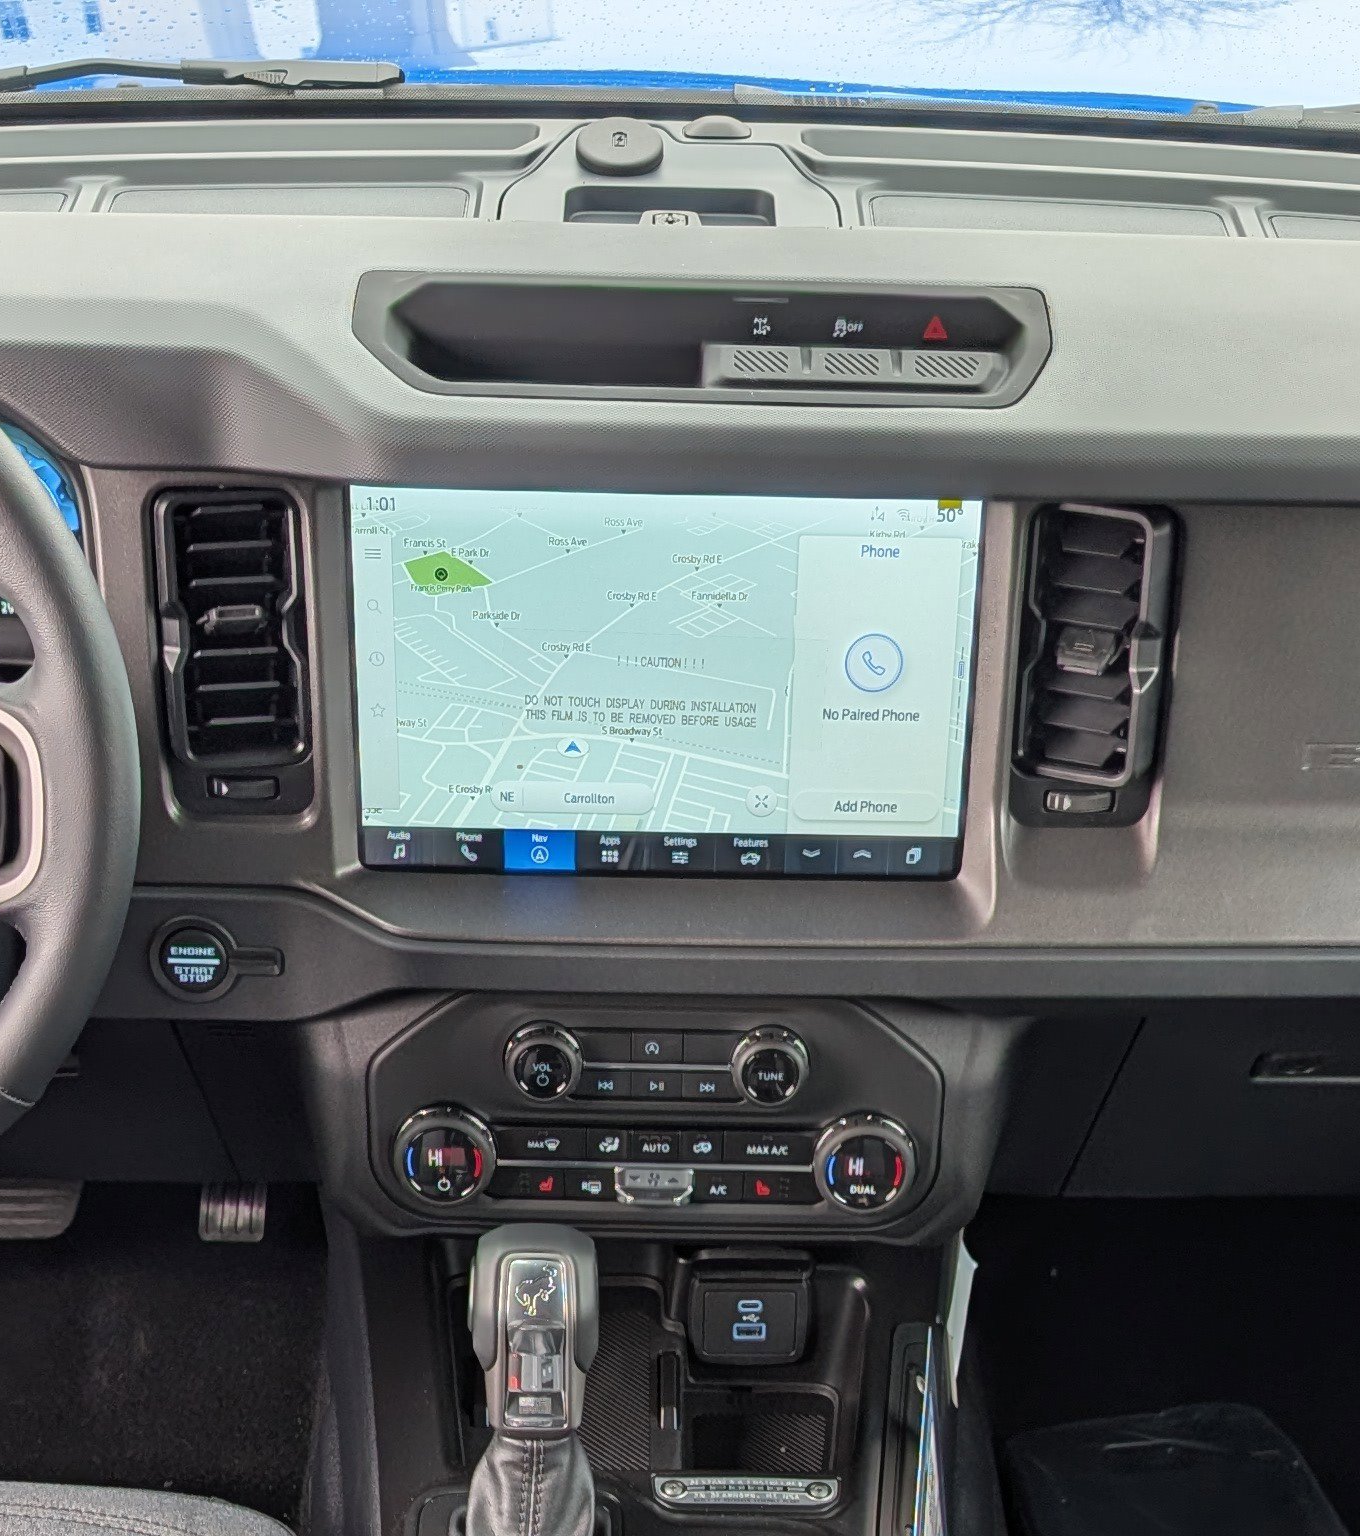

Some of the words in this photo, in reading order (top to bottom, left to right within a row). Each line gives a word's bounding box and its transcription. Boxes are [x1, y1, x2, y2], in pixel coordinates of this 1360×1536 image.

[366, 497, 396, 511] 1:01
[604, 517, 624, 526] Ross
[626, 517, 643, 527] Ave
[403, 538, 435, 548] Francis
[436, 539, 446, 548] St
[548, 537, 569, 546] Ross
[571, 537, 588, 546] Ave
[458, 549, 478, 558] Park
[479, 549, 490, 558] Dr
[861, 544, 900, 559] Phone
[672, 553, 702, 564] Crosby
[704, 554, 715, 563] Rd
[607, 591, 636, 601] Crosby
[638, 591, 649, 601] Rd
[472, 611, 509, 620] Parkside
[510, 611, 520, 620] Dr
[541, 642, 569, 653] Crosby
[571, 643, 583, 652] Rd
[524, 695, 539, 706] DO
[543, 696, 564, 707] NOT
[568, 697, 601, 708] TOUCH
[605, 698, 645, 709] DISPLAY
[650, 699, 686, 711] DURING
[691, 700, 757, 714] INSTALLATION
[525, 709, 546, 720] THIS
[551, 710, 573, 721] FILM
[578, 711, 587, 722] IS
[593, 712, 606, 722] TO
[610, 712, 624, 723] BE
[629, 713, 676, 725] REMOVED
[681, 715, 719, 726] BEFORE
[724, 716, 757, 728] USAGE
[822, 708, 839, 721] No
[841, 708, 880, 722] Paired
[881, 709, 920, 722] Phone
[417, 718, 427, 727] St
[601, 726, 607, 735] S
[609, 726, 651, 737] Broadway
[653, 727, 662, 736] St
[455, 785, 483, 795] Crosby
[500, 791, 515, 802] NE
[564, 793, 615, 804] Carrollton
[834, 801, 858, 813] Add
[860, 801, 898, 813] Phone
[455, 832, 483, 843] Phone
[531, 833, 548, 843] Nav
[599, 835, 621, 847] Apps
[663, 836, 698, 848] Settings
[733, 837, 768, 848] Features
[170, 946, 216, 956] ENGINE
[173, 966, 216, 975] START
[178, 974, 214, 983] STOP
[532, 1062, 552, 1073] VOL
[757, 1072, 785, 1082] TUNE
[642, 1143, 671, 1154] AUTO
[746, 1144, 770, 1155] MAX
[771, 1145, 789, 1156] A/C
[847, 1156, 865, 1176] HI
[709, 1184, 728, 1196] A/C
[849, 1184, 877, 1195] DUAL
